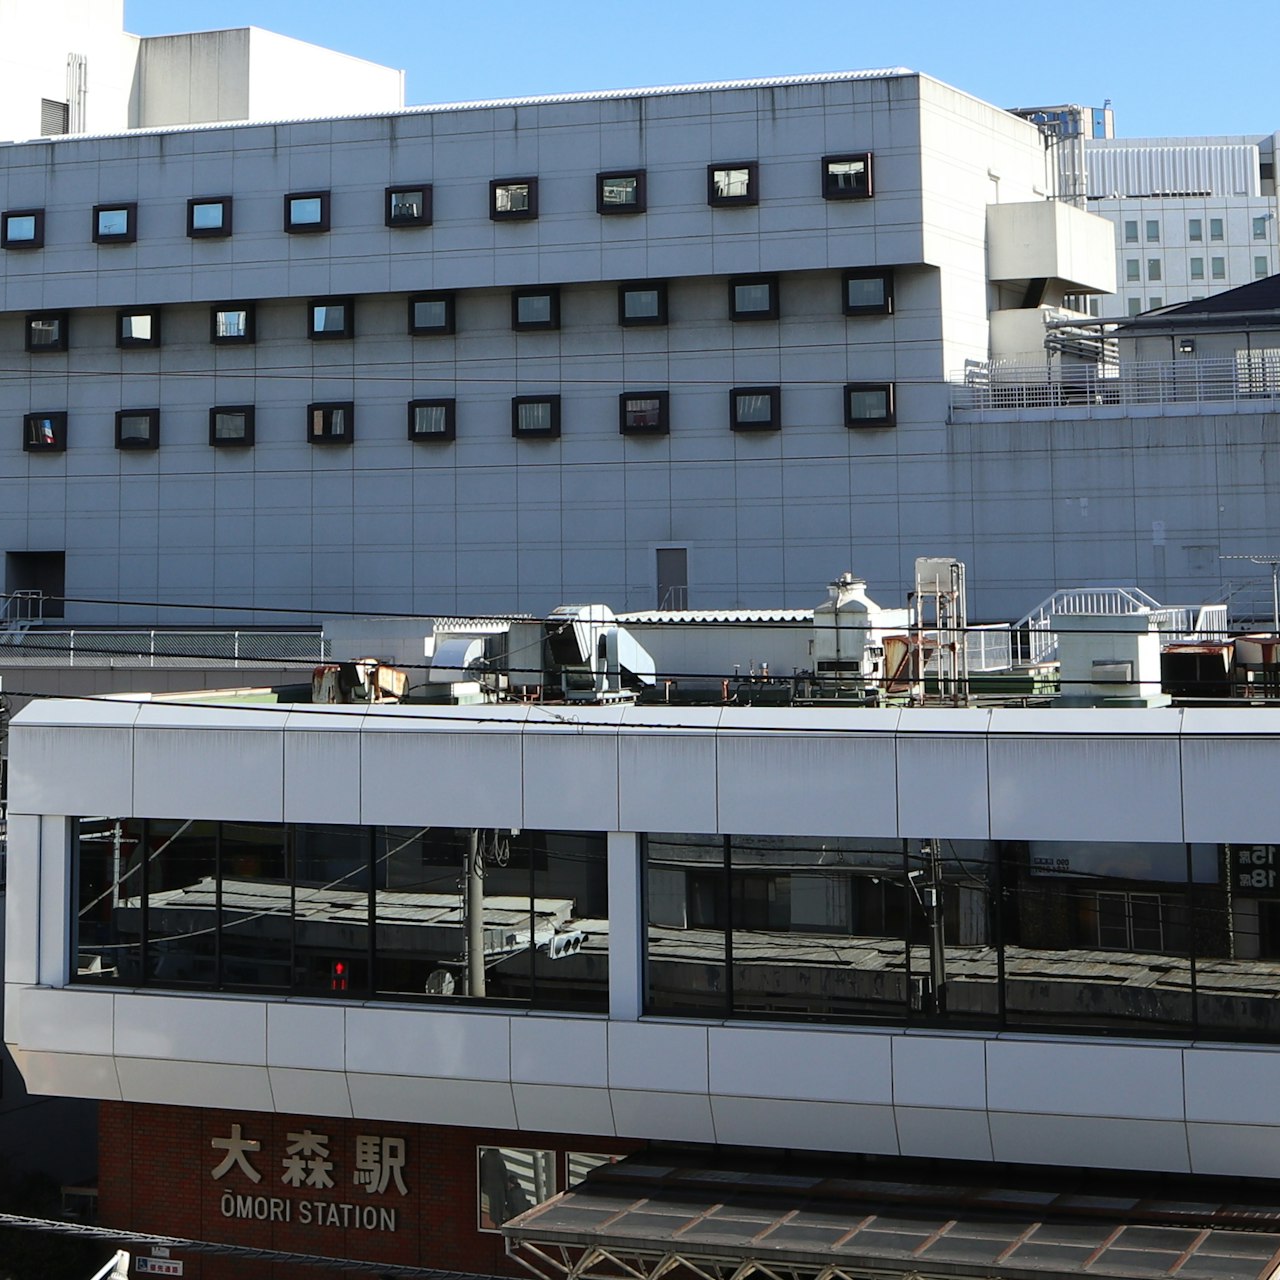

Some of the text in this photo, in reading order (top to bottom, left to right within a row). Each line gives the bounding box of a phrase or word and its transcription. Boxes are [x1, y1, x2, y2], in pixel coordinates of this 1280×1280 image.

[210, 1123, 409, 1197] 大森駅
[221, 1188, 396, 1233] ŌMORI STATION
